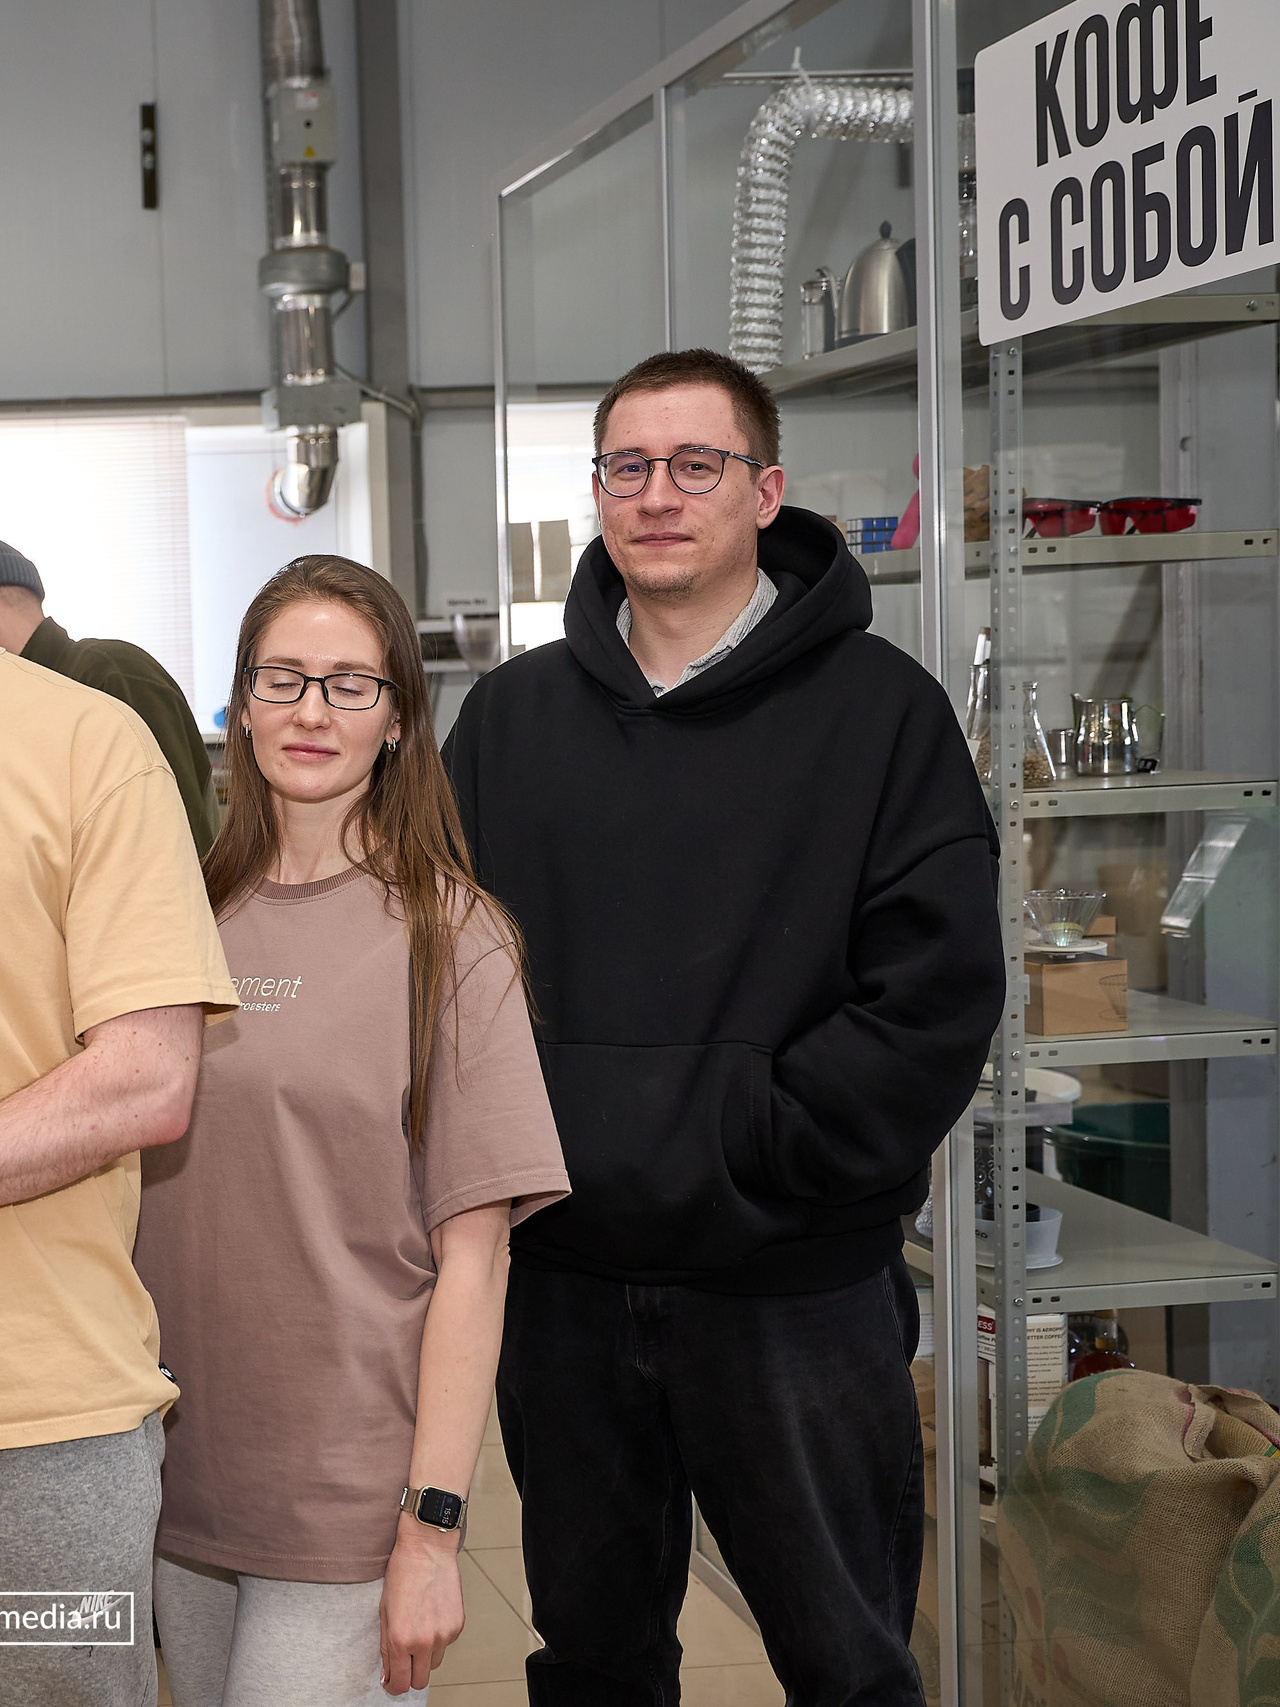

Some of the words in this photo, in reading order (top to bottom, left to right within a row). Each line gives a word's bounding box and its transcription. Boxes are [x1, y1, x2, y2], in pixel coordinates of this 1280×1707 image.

[1035, 0, 1217, 167] КОФЕ
[999, 197, 1031, 321] С
[1050, 88, 1275, 305] СОБОЙ
